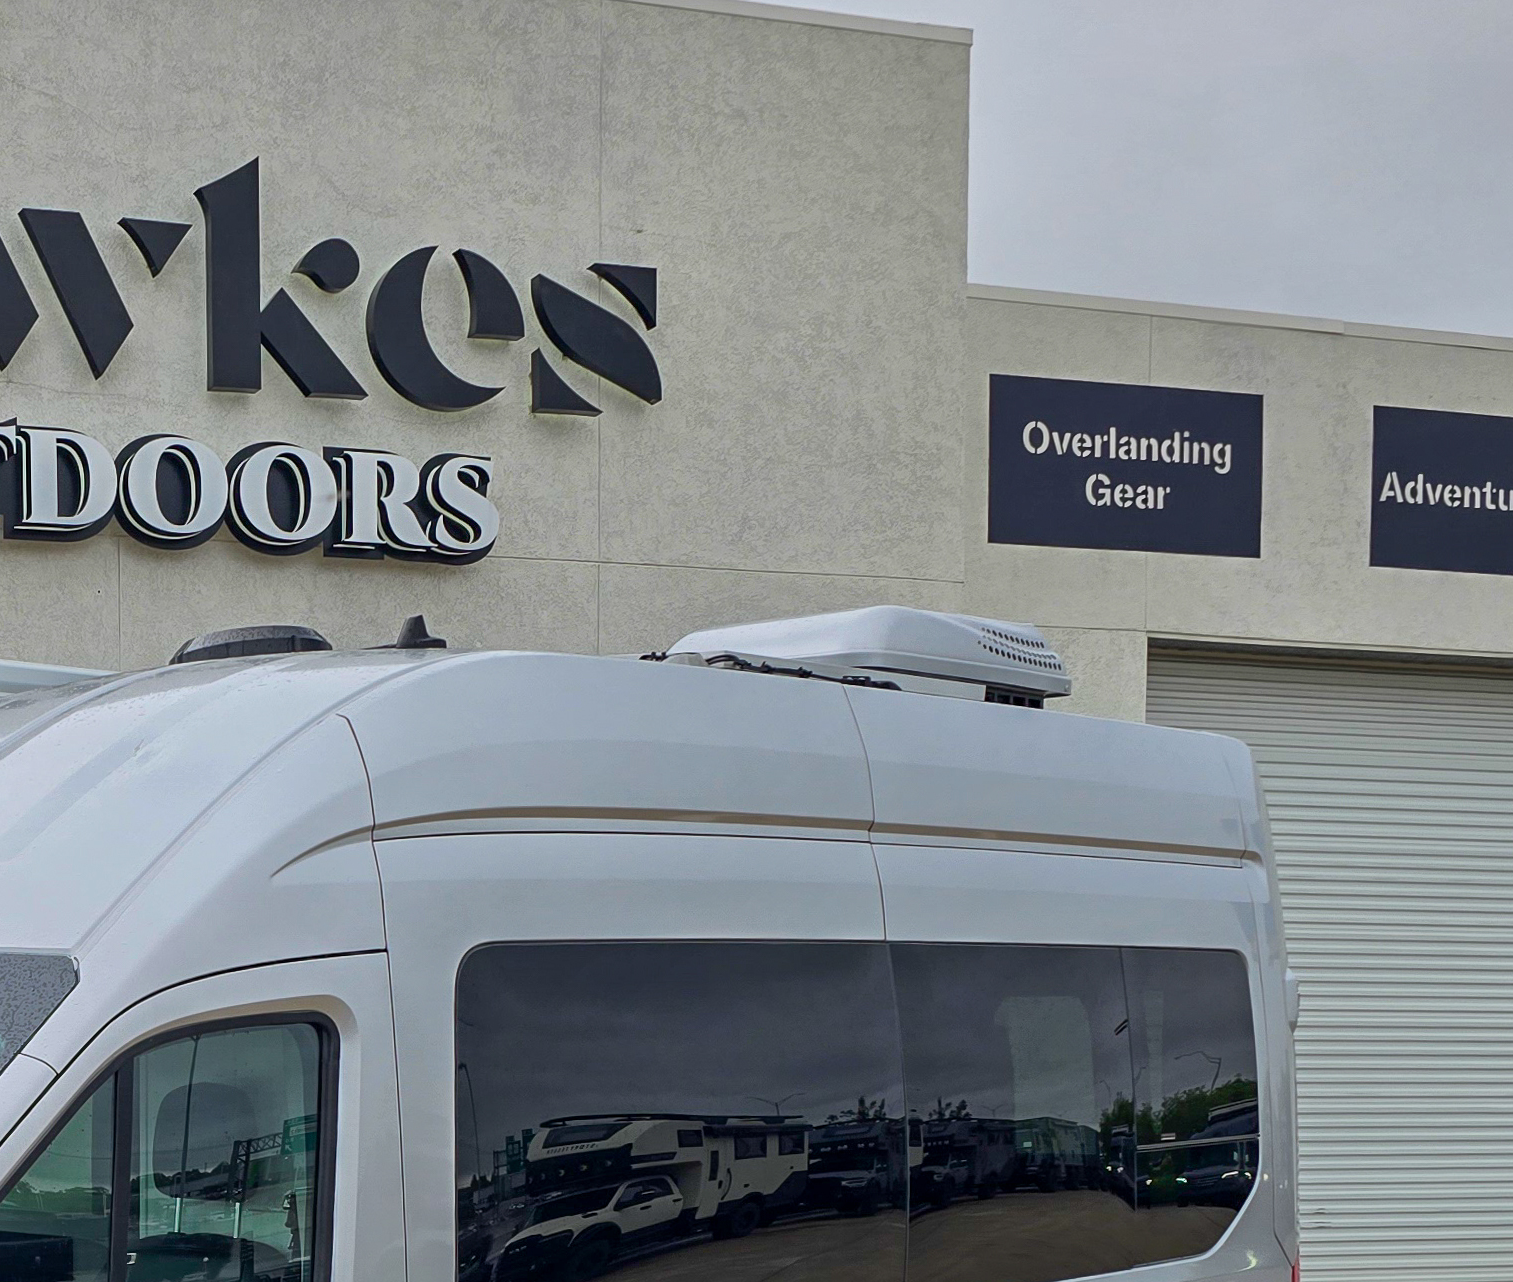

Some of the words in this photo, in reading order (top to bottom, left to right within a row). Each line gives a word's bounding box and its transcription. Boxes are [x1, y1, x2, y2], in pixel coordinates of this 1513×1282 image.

[1022, 420, 1233, 474] Overlanding
[1085, 473, 1171, 510] Gear
[1379, 471, 1513, 511] Adventu
